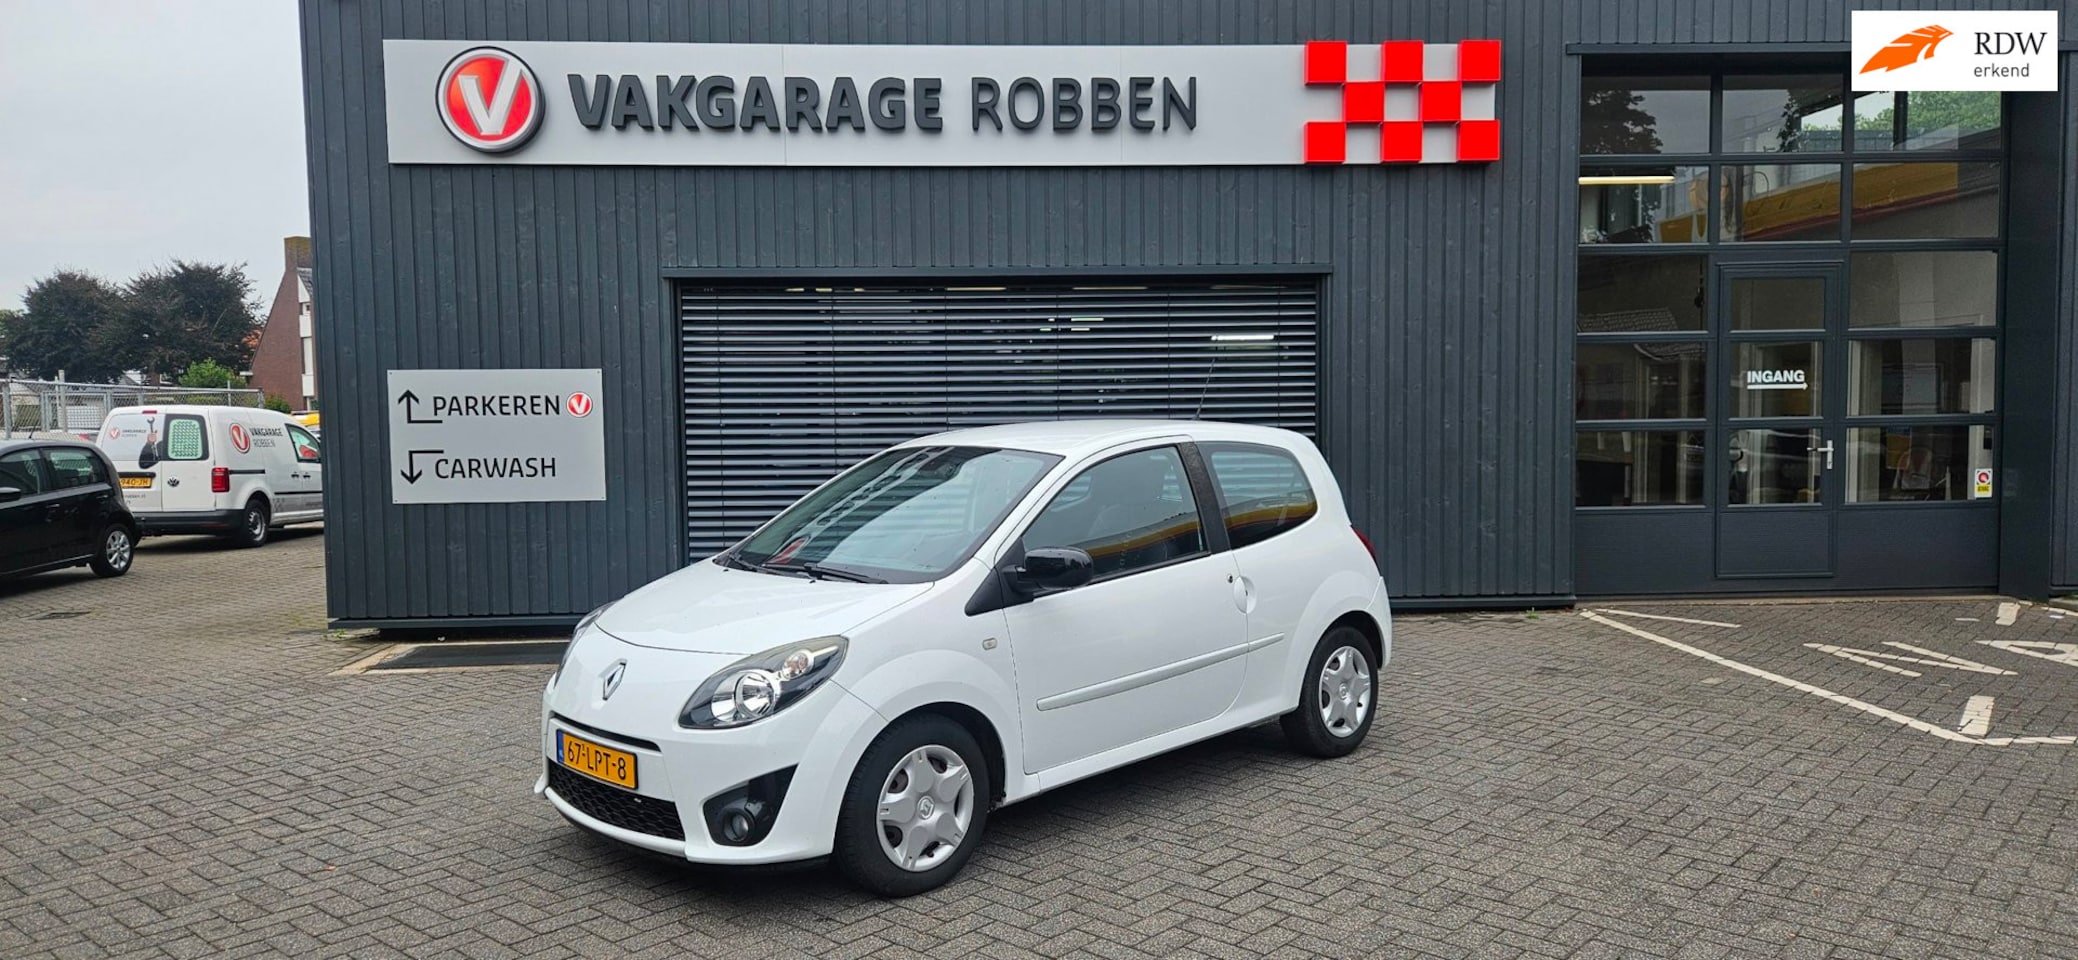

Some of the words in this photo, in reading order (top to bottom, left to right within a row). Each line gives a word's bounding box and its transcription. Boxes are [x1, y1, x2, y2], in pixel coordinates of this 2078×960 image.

[567, 74, 943, 132] VAKGARAGE
[971, 76, 1197, 131] ROBBEN
[1747, 369, 1805, 383] INGANG
[433, 395, 560, 416] PARKEREN
[435, 457, 556, 478] CARWASH
